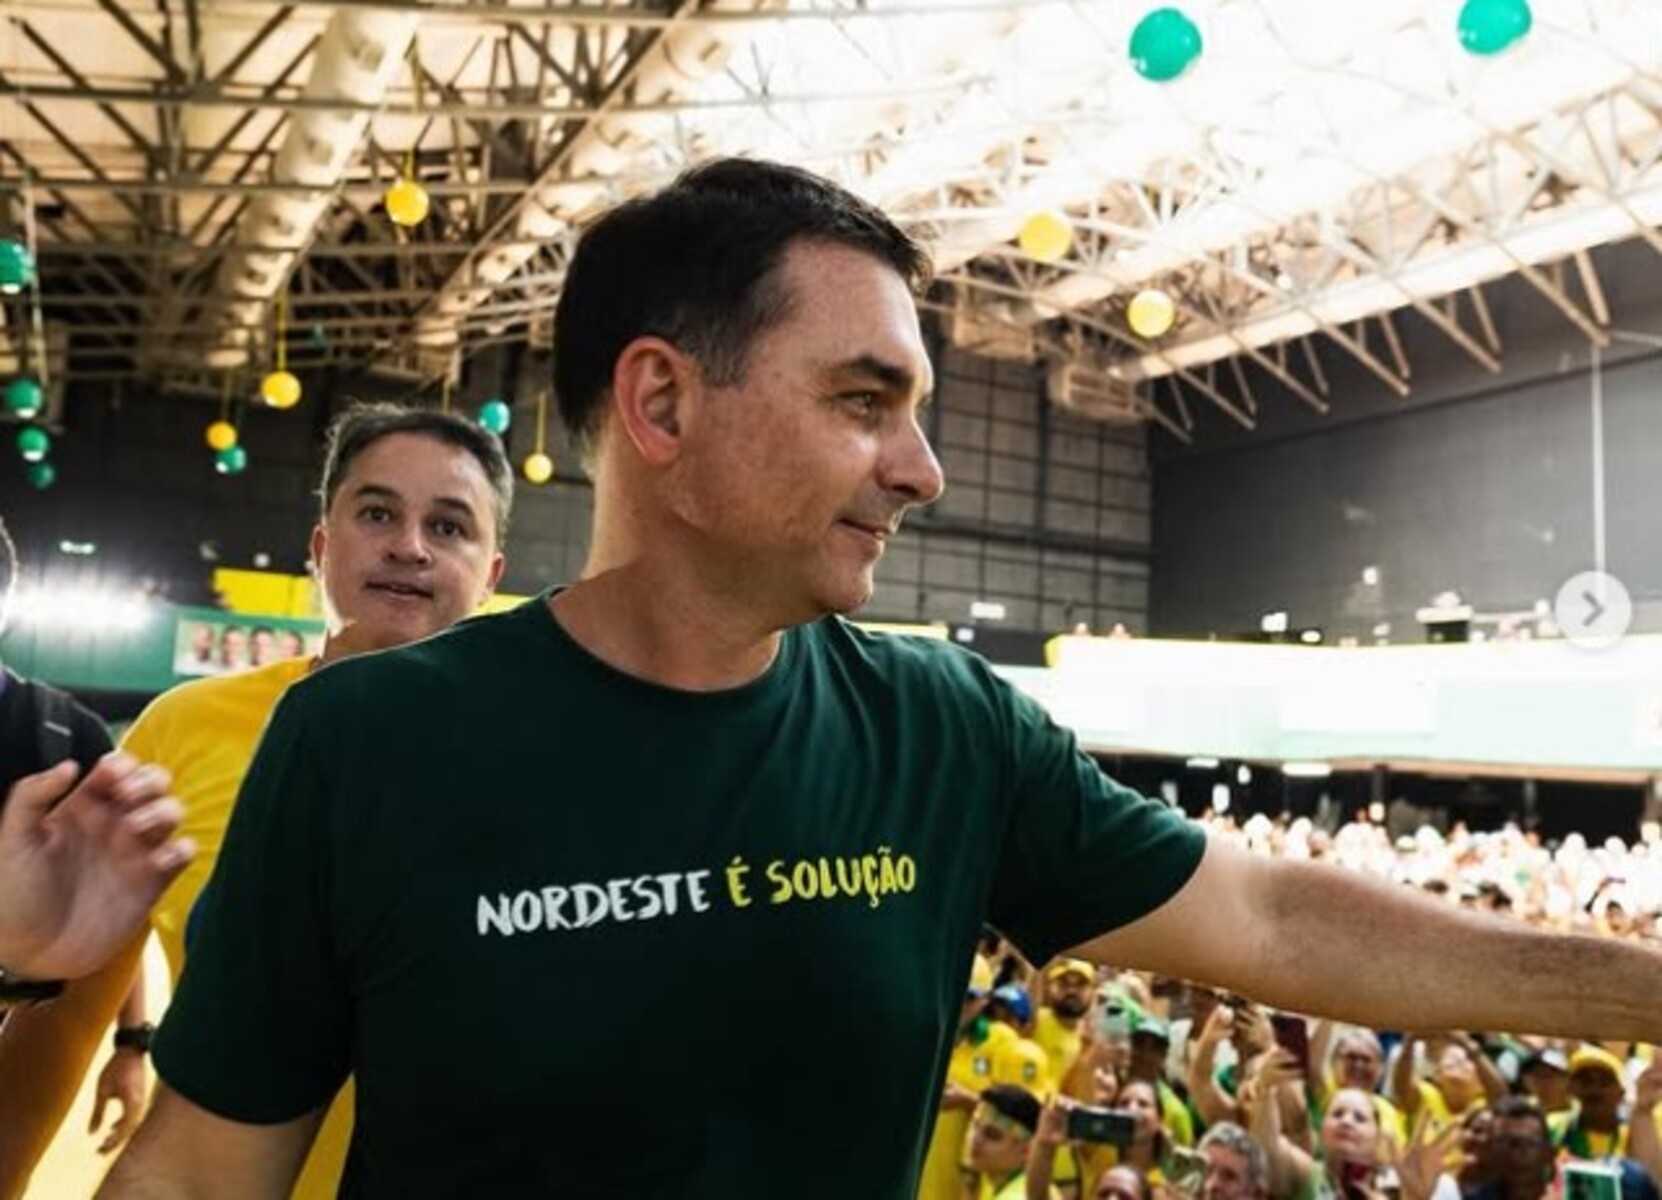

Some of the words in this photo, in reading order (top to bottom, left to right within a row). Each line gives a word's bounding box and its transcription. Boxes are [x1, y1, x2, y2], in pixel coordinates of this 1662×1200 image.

[476, 870, 711, 936] NORDESTE
[726, 856, 752, 907] É
[766, 846, 916, 908] SOLUÇÃO
